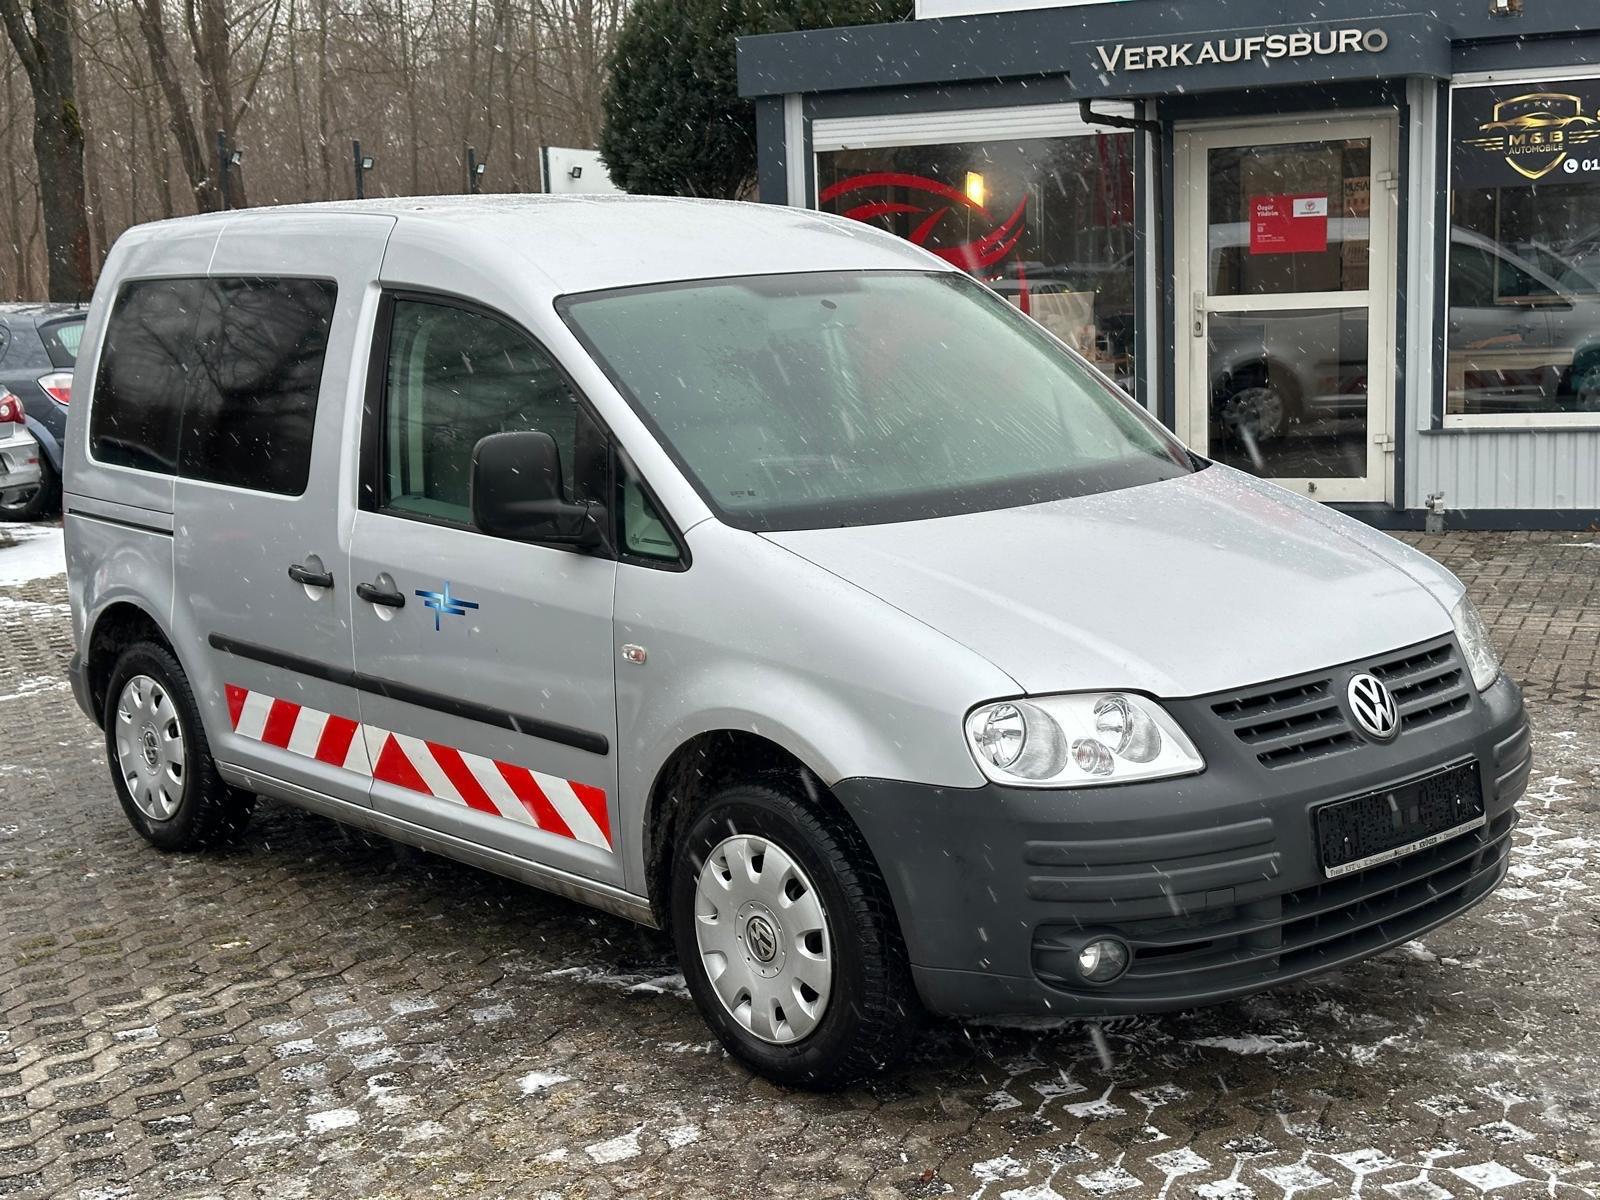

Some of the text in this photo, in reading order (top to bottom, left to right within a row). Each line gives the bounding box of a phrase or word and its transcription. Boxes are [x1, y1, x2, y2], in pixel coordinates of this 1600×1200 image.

[1509, 134, 1526, 146] M
[1550, 131, 1563, 142] B
[1508, 143, 1564, 155] AUTOMOBILE
